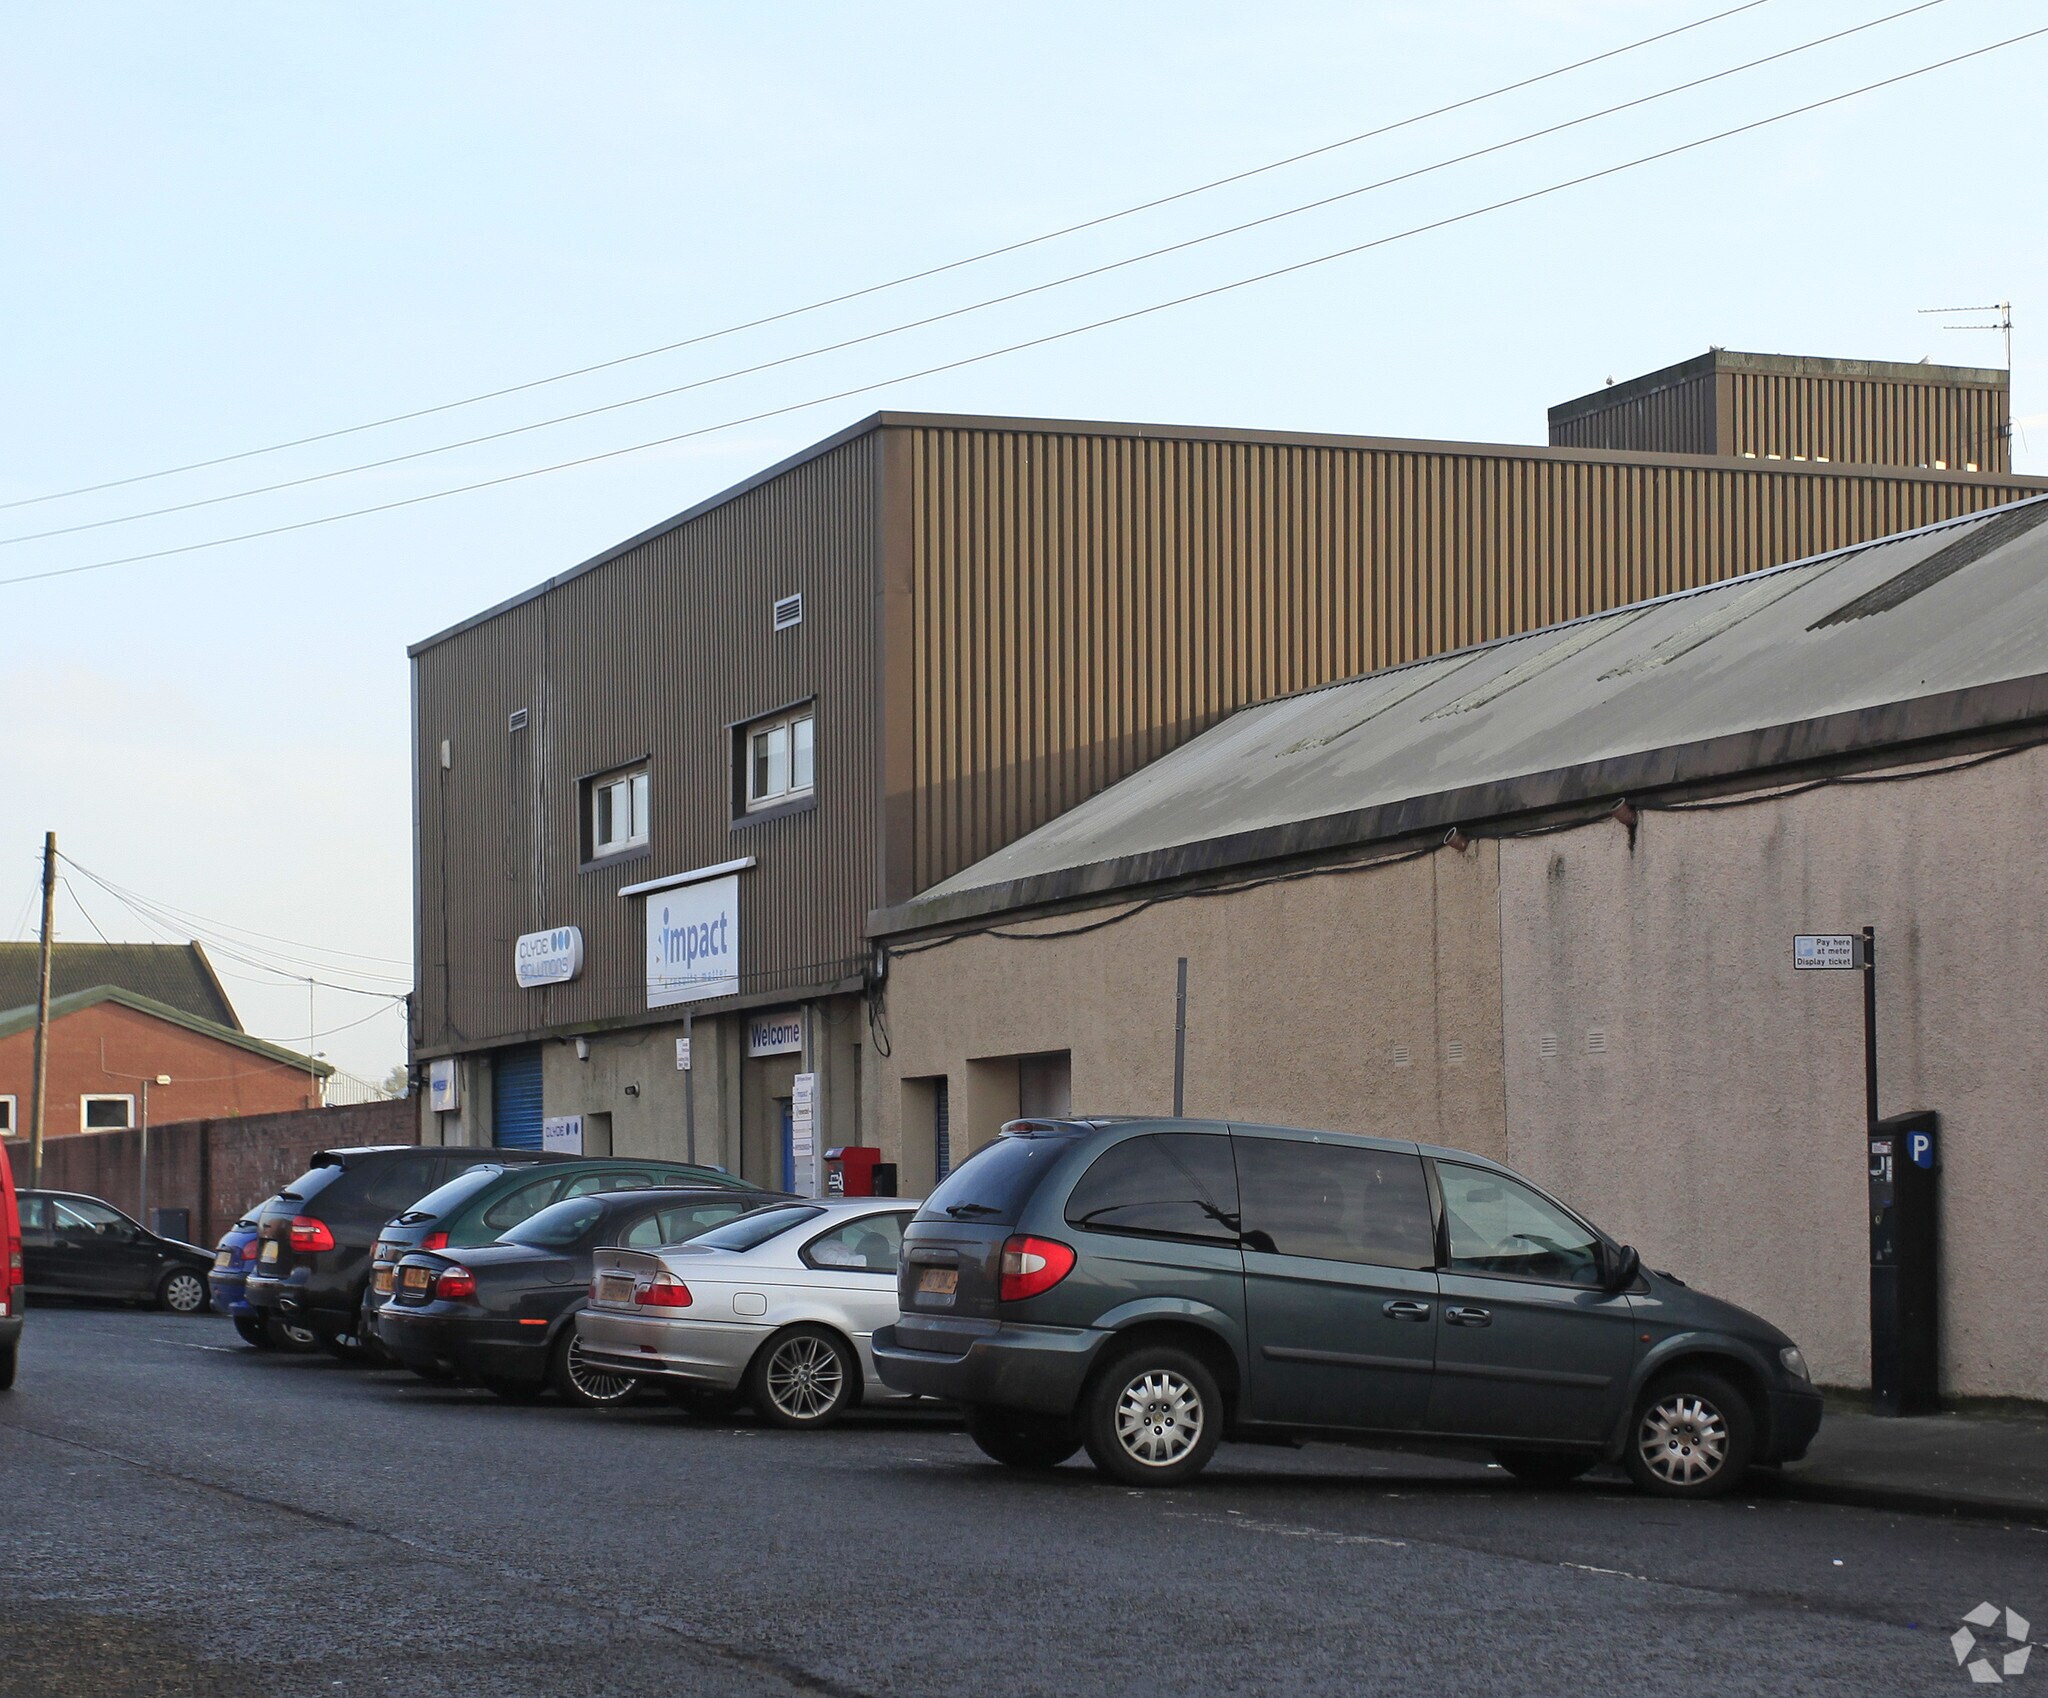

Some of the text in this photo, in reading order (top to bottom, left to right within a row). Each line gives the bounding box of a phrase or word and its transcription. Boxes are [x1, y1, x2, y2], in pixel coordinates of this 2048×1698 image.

[520, 938, 548, 958] CLYDE
[663, 907, 728, 969] impact
[1816, 938, 1851, 947] Pay here
[1797, 958, 1826, 966] Display
[751, 1022, 800, 1048] Welcome
[1913, 1135, 1929, 1161] P
